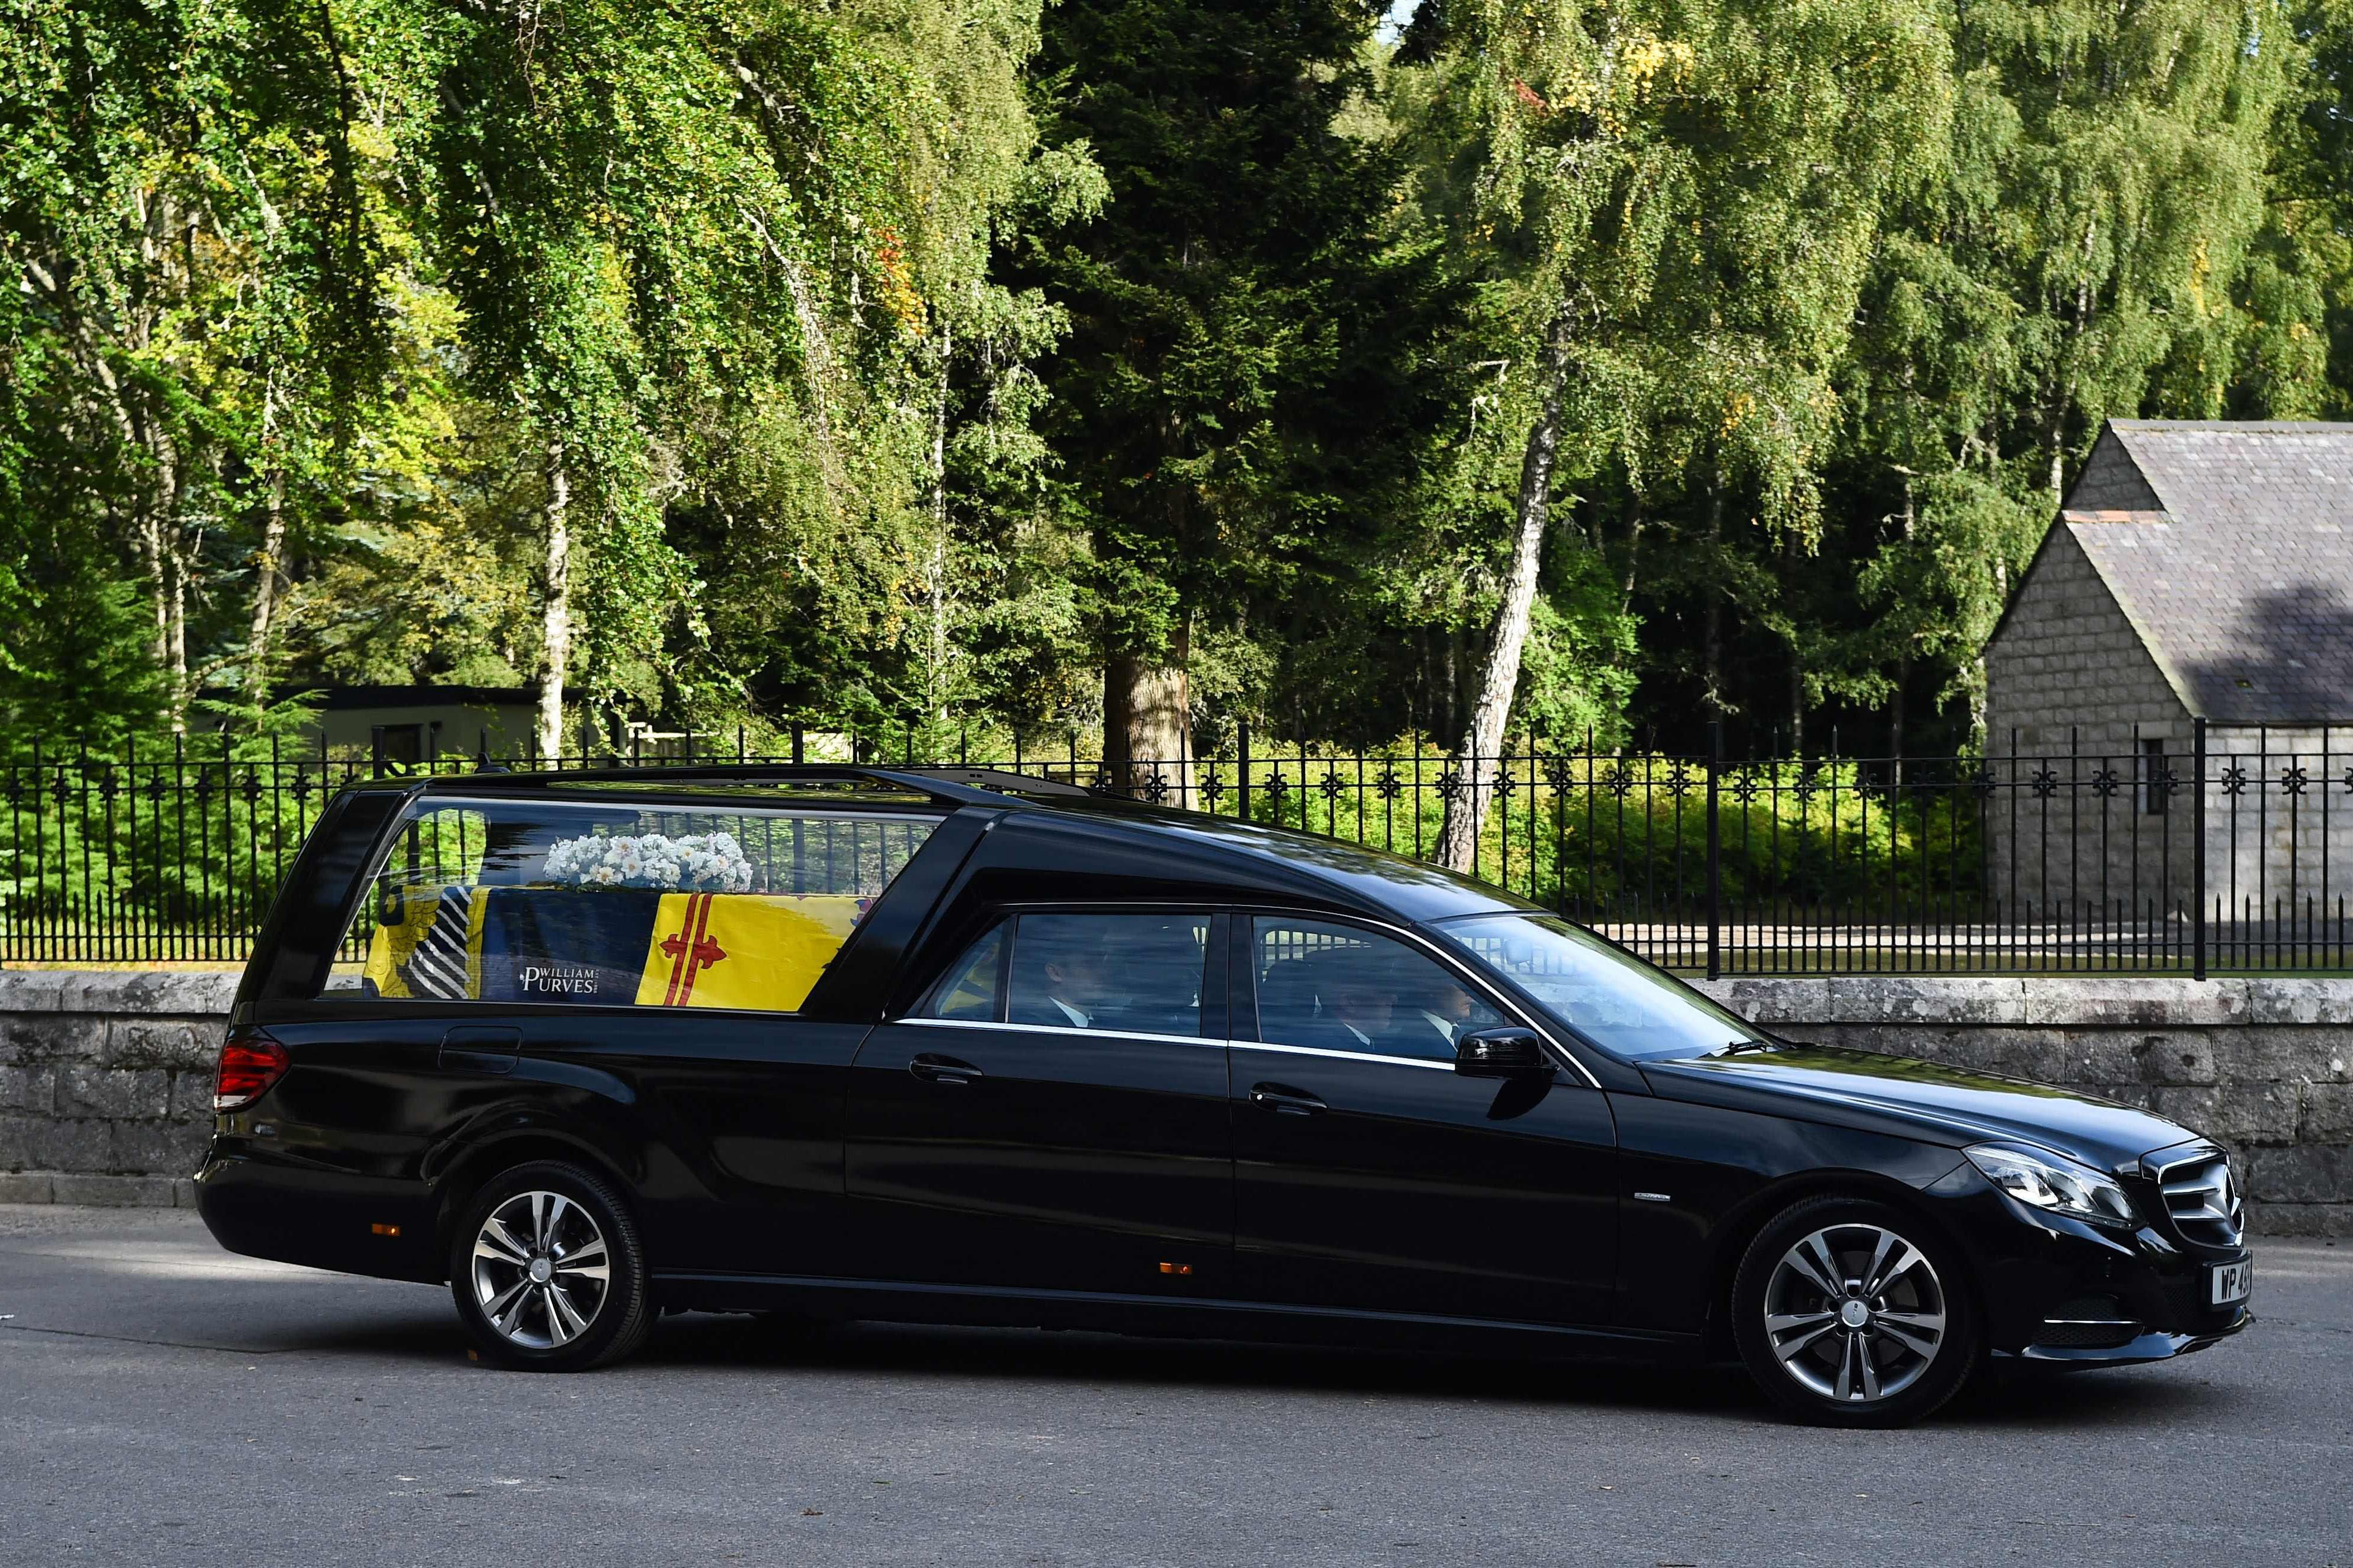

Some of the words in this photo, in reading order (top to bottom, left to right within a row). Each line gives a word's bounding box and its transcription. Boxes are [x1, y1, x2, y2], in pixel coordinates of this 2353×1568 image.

[522, 967, 593, 993] PURVES
[540, 967, 594, 979] WILLIAM
[2221, 1267, 2237, 1300] WP
